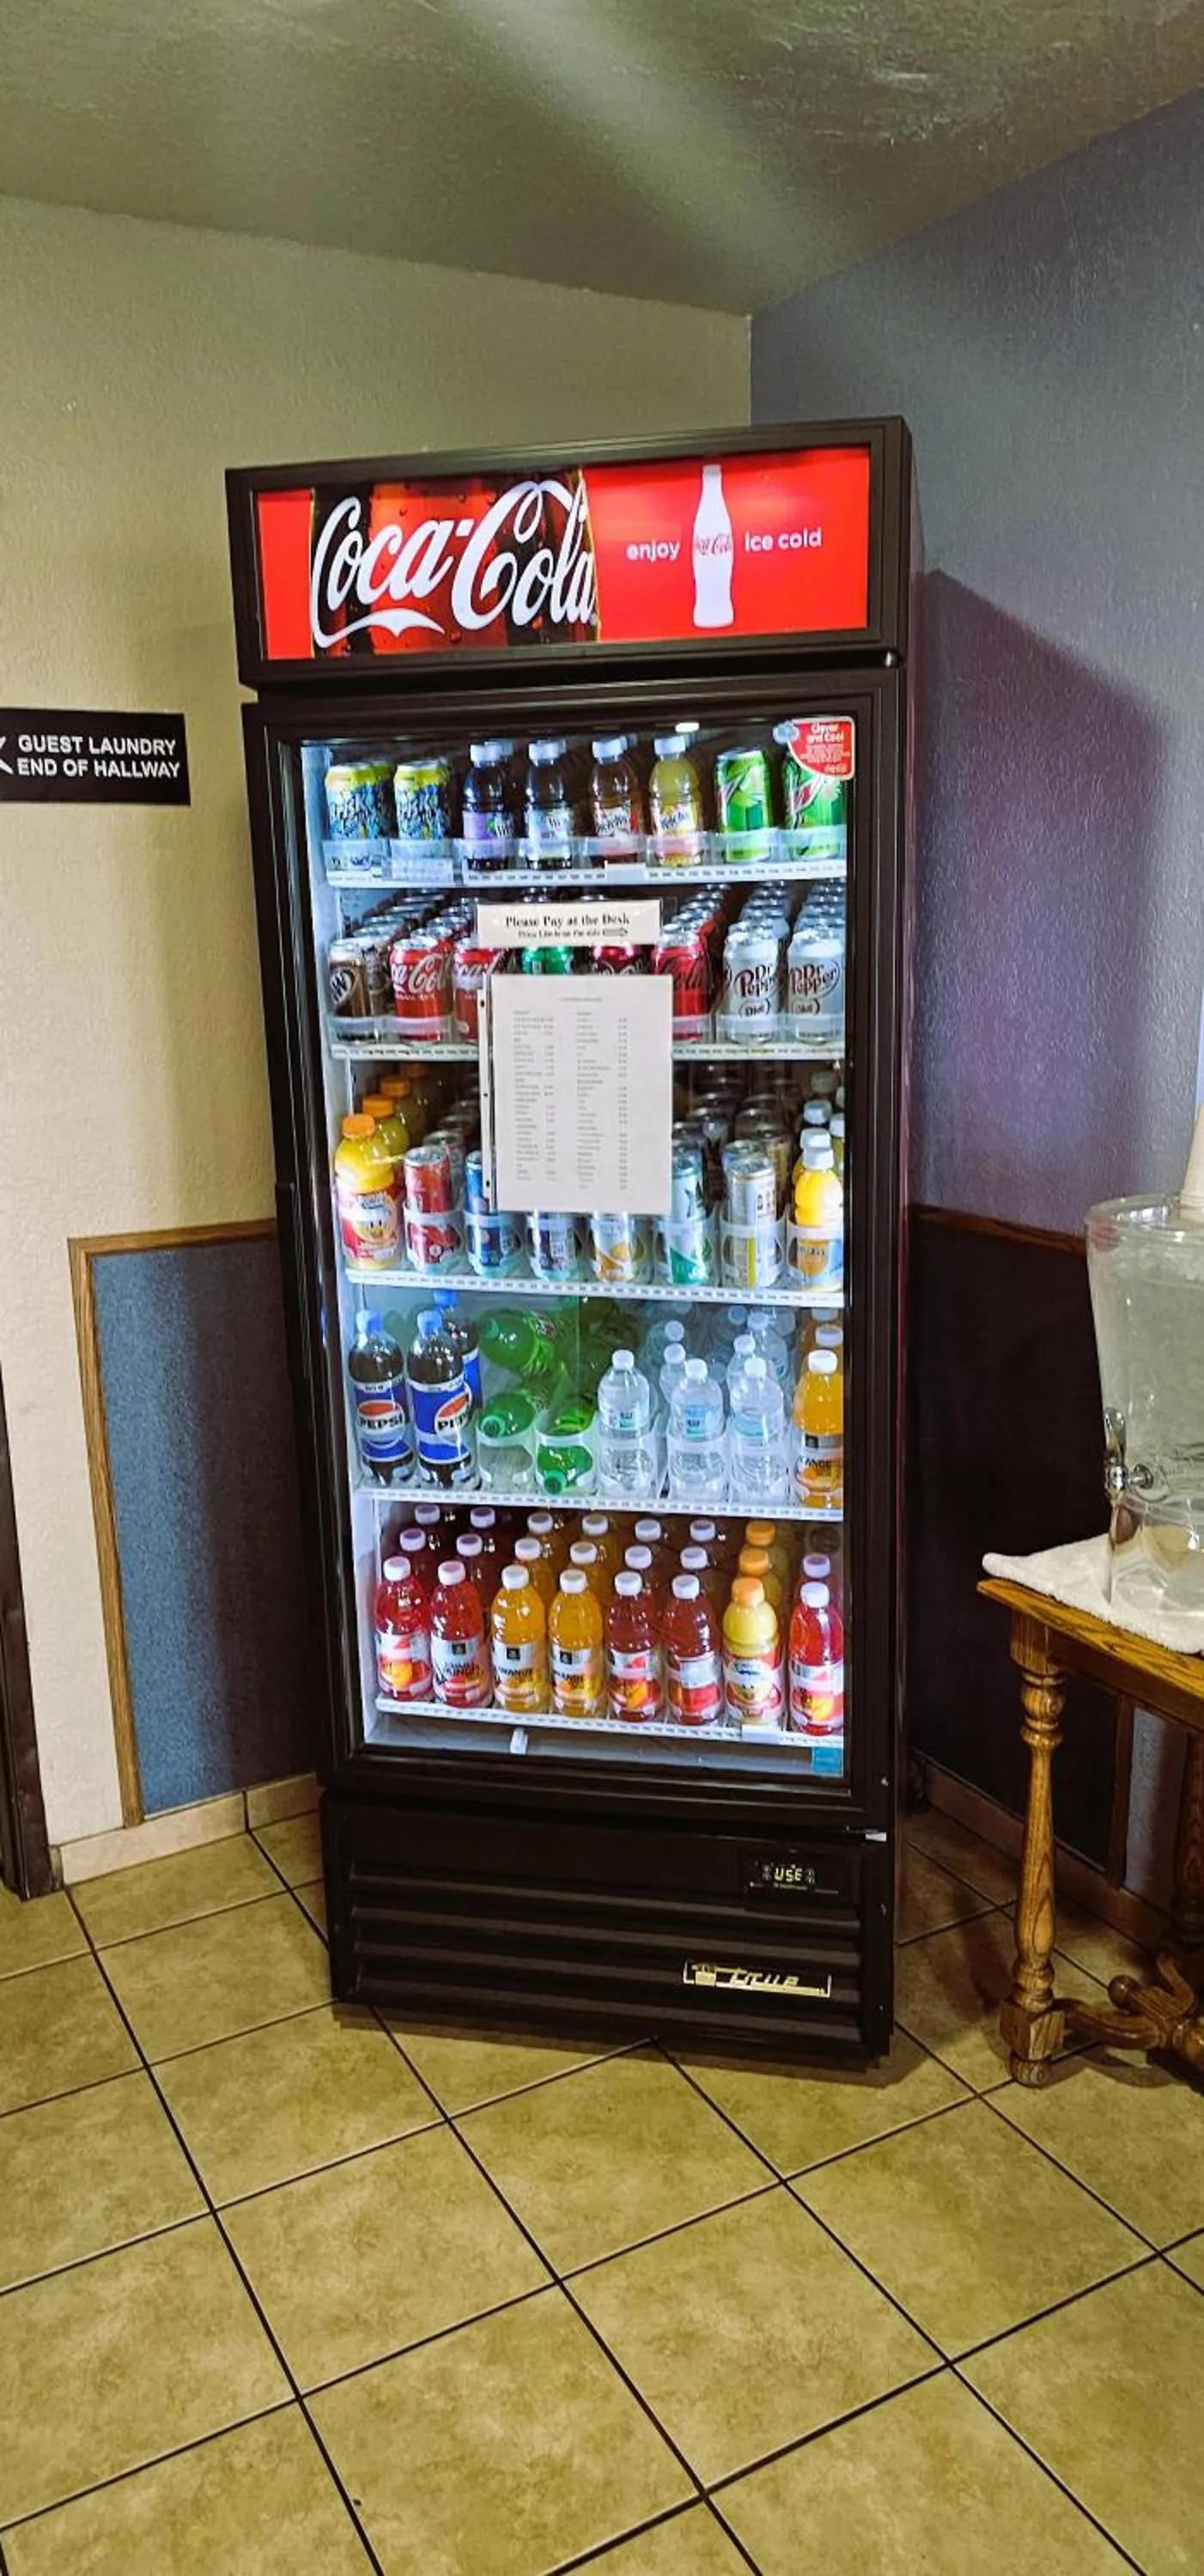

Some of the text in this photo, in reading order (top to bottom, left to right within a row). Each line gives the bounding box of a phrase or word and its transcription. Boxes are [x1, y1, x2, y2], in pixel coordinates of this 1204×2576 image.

[745, 527, 822, 552] ice cold
[627, 540, 680, 562] enjoy
[311, 478, 598, 648] Coca-Cola
[18, 734, 176, 756] GUEST LAUNDRY
[17, 757, 180, 777] END OF HALLWAY
[505, 912, 629, 929] Please Pay at the Desk
[359, 1413, 403, 1430] PEPSI
